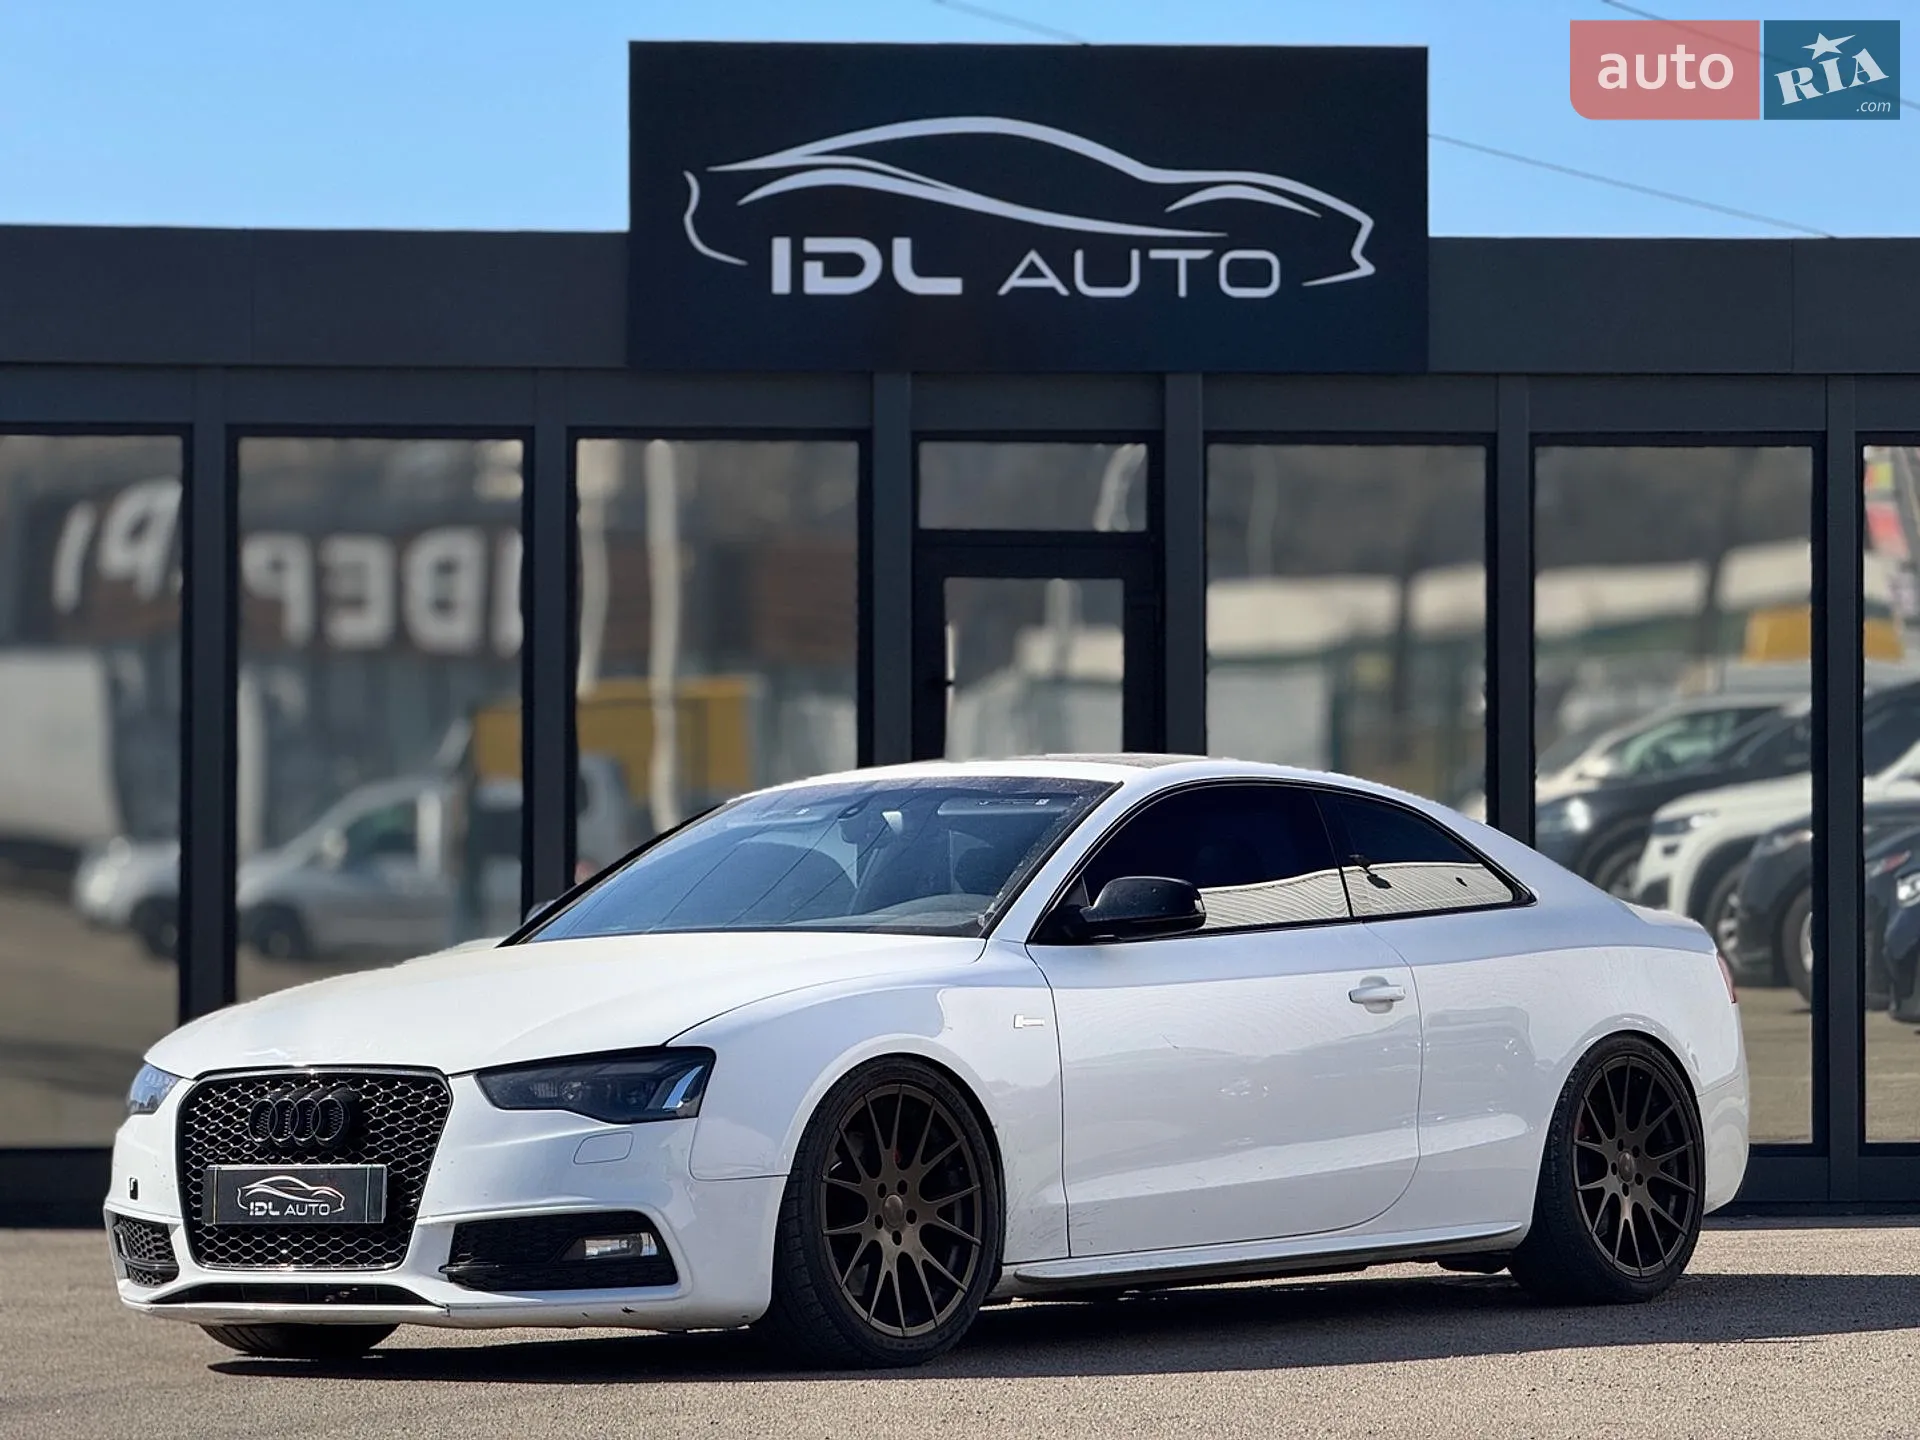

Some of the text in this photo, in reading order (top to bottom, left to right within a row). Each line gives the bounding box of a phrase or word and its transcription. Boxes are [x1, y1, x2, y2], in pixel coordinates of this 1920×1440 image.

[771, 237, 1281, 298] IDL AUTO
[249, 1201, 331, 1217] IDL AUTO
